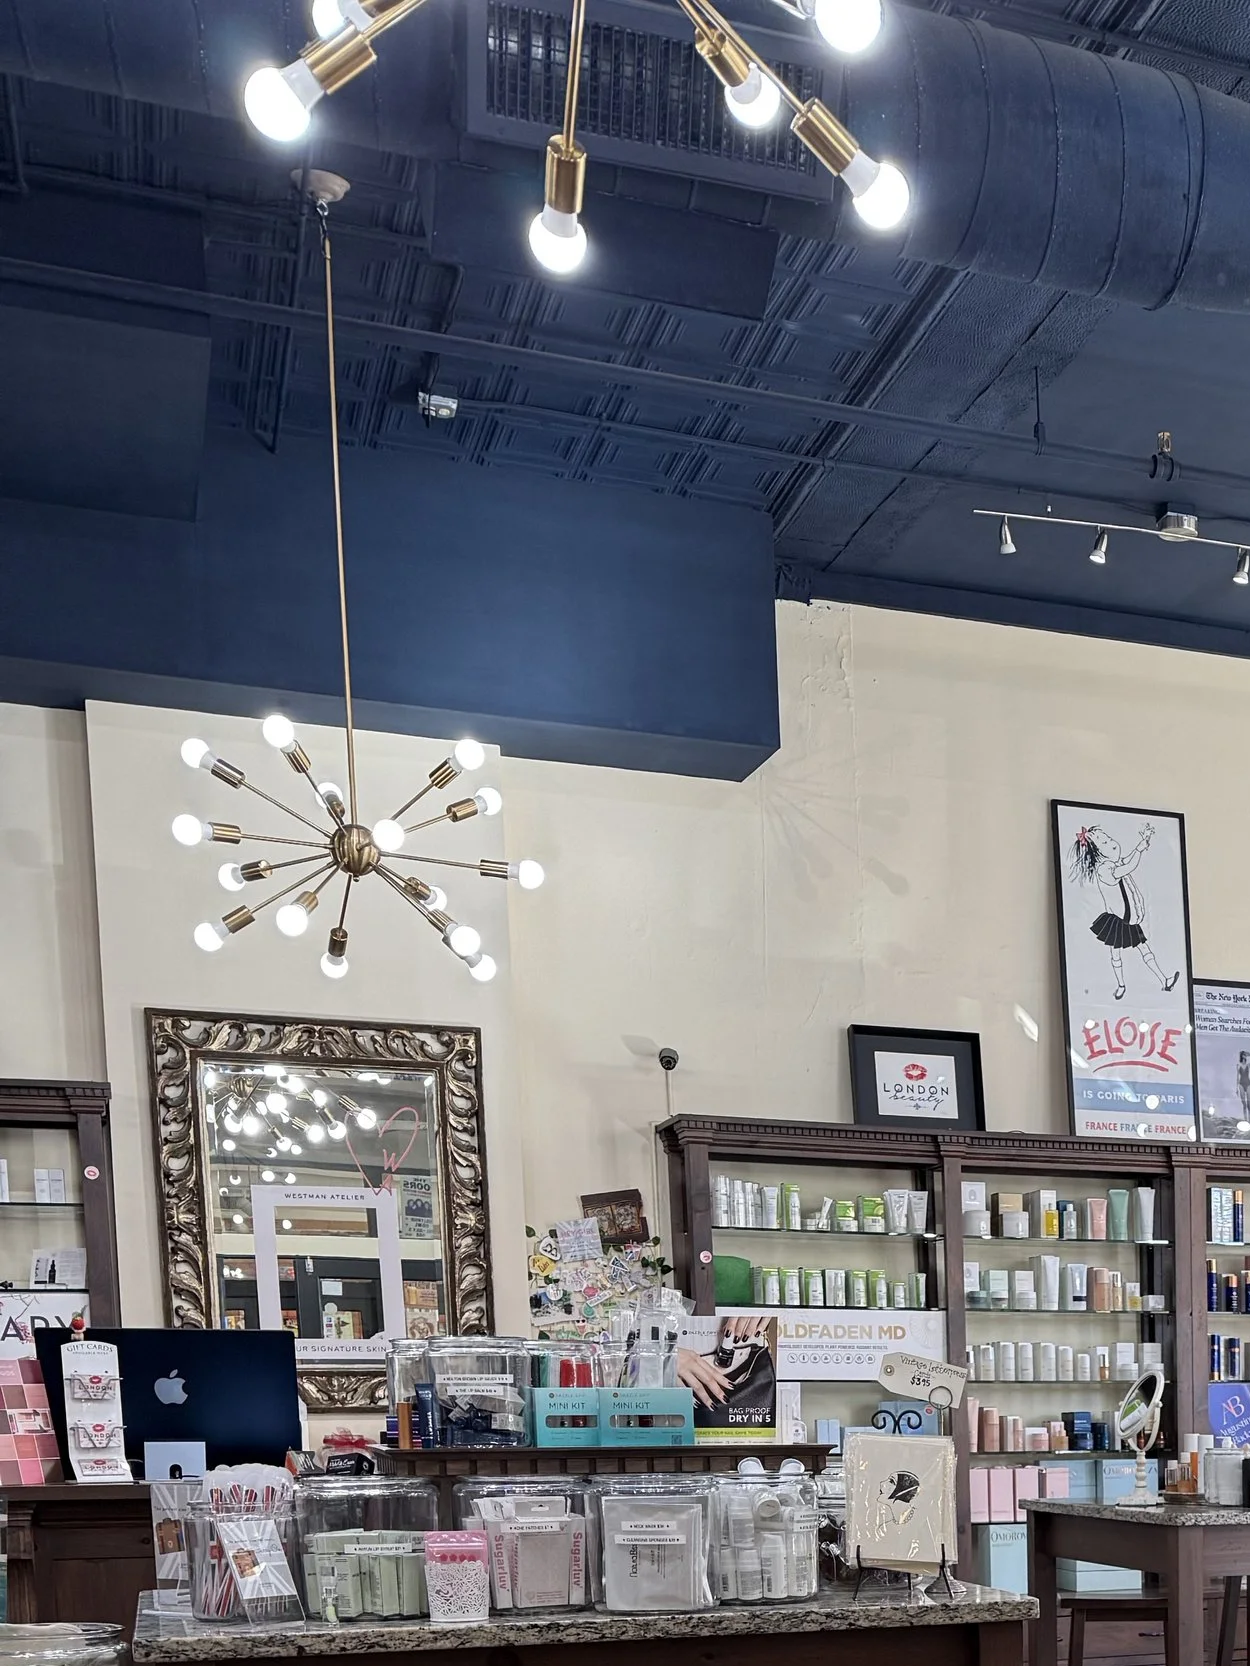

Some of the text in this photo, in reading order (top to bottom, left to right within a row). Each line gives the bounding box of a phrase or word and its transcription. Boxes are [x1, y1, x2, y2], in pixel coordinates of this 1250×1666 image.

[1206, 992, 1217, 1000] The
[1219, 993, 1231, 1001] New
[1233, 994, 1247, 1003] York
[1195, 1015, 1216, 1023] Woman
[1218, 1016, 1241, 1024] Searches
[1081, 1016, 1182, 1065] ELOISE
[883, 1083, 949, 1096] LONDON
[1083, 1090, 1093, 1099] IS
[1097, 1091, 1132, 1101] GOING
[889, 1090, 944, 1111] beauty
[1085, 1121, 1186, 1135] FRANCE FRAE FRANCE
[330, 1193, 365, 1201] ATELIER
[777, 1324, 906, 1340] LDFADEN MD
[67, 1343, 113, 1352] GIFT CARDS
[549, 1402, 586, 1410] MINI KIT
[729, 1415, 749, 1423] DRY
[752, 1415, 762, 1423] IN
[494, 1535, 508, 1590] Sugarluv
[571, 1532, 583, 1587] Sugarluv
